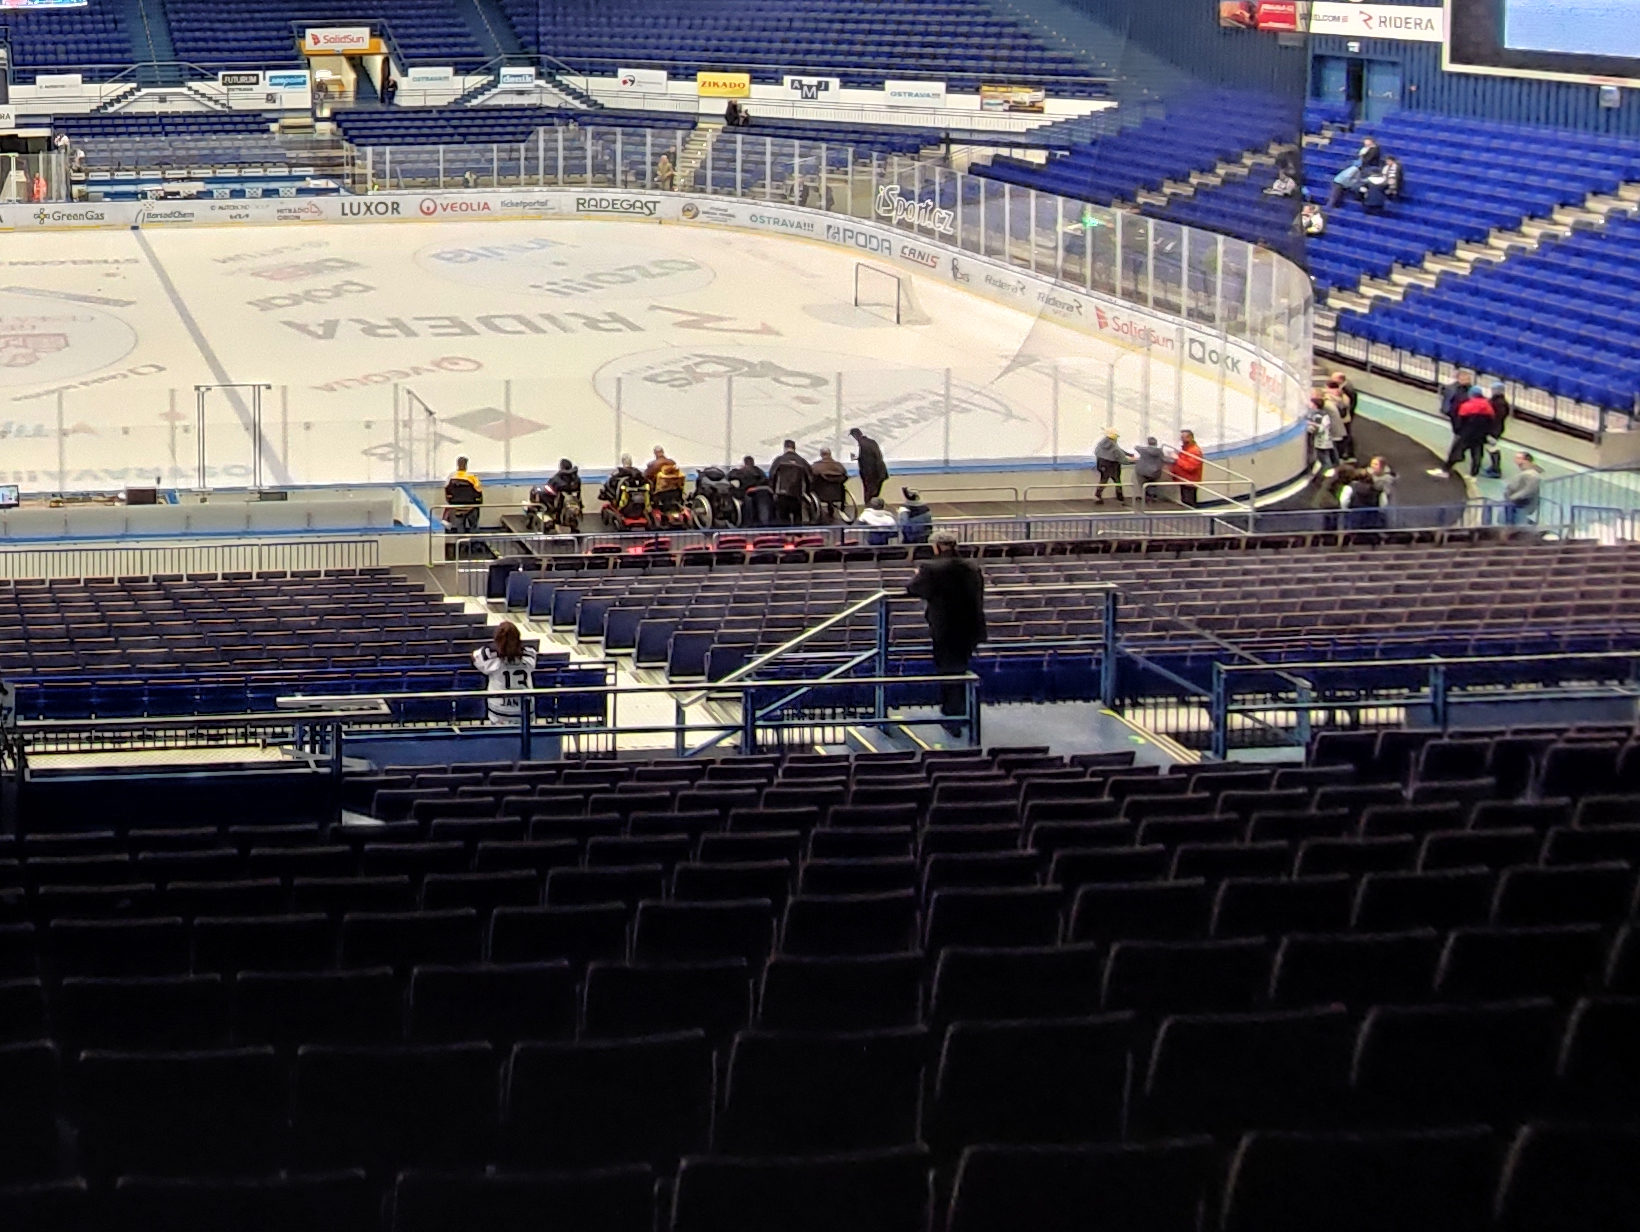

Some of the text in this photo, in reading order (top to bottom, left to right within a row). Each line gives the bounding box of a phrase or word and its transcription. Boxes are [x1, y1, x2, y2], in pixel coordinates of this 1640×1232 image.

[1378, 15, 1435, 32] RIDERA
[323, 33, 365, 44] SolidSun
[223, 75, 258, 85] FUTURUM
[700, 80, 746, 89] ZIKADO
[52, 210, 105, 222] GreenGas
[341, 201, 401, 216] LUXOR
[440, 200, 491, 213] VEOLIA
[576, 197, 661, 217] RADEGAST
[749, 213, 814, 233] OSTRAVA!!!
[842, 227, 892, 257] PODA
[900, 244, 941, 263] CANIS
[280, 309, 646, 340] RIDERA
[1112, 315, 1175, 350] SolidSun
[1208, 348, 1242, 374] OKK
[502, 669, 529, 689] 13
